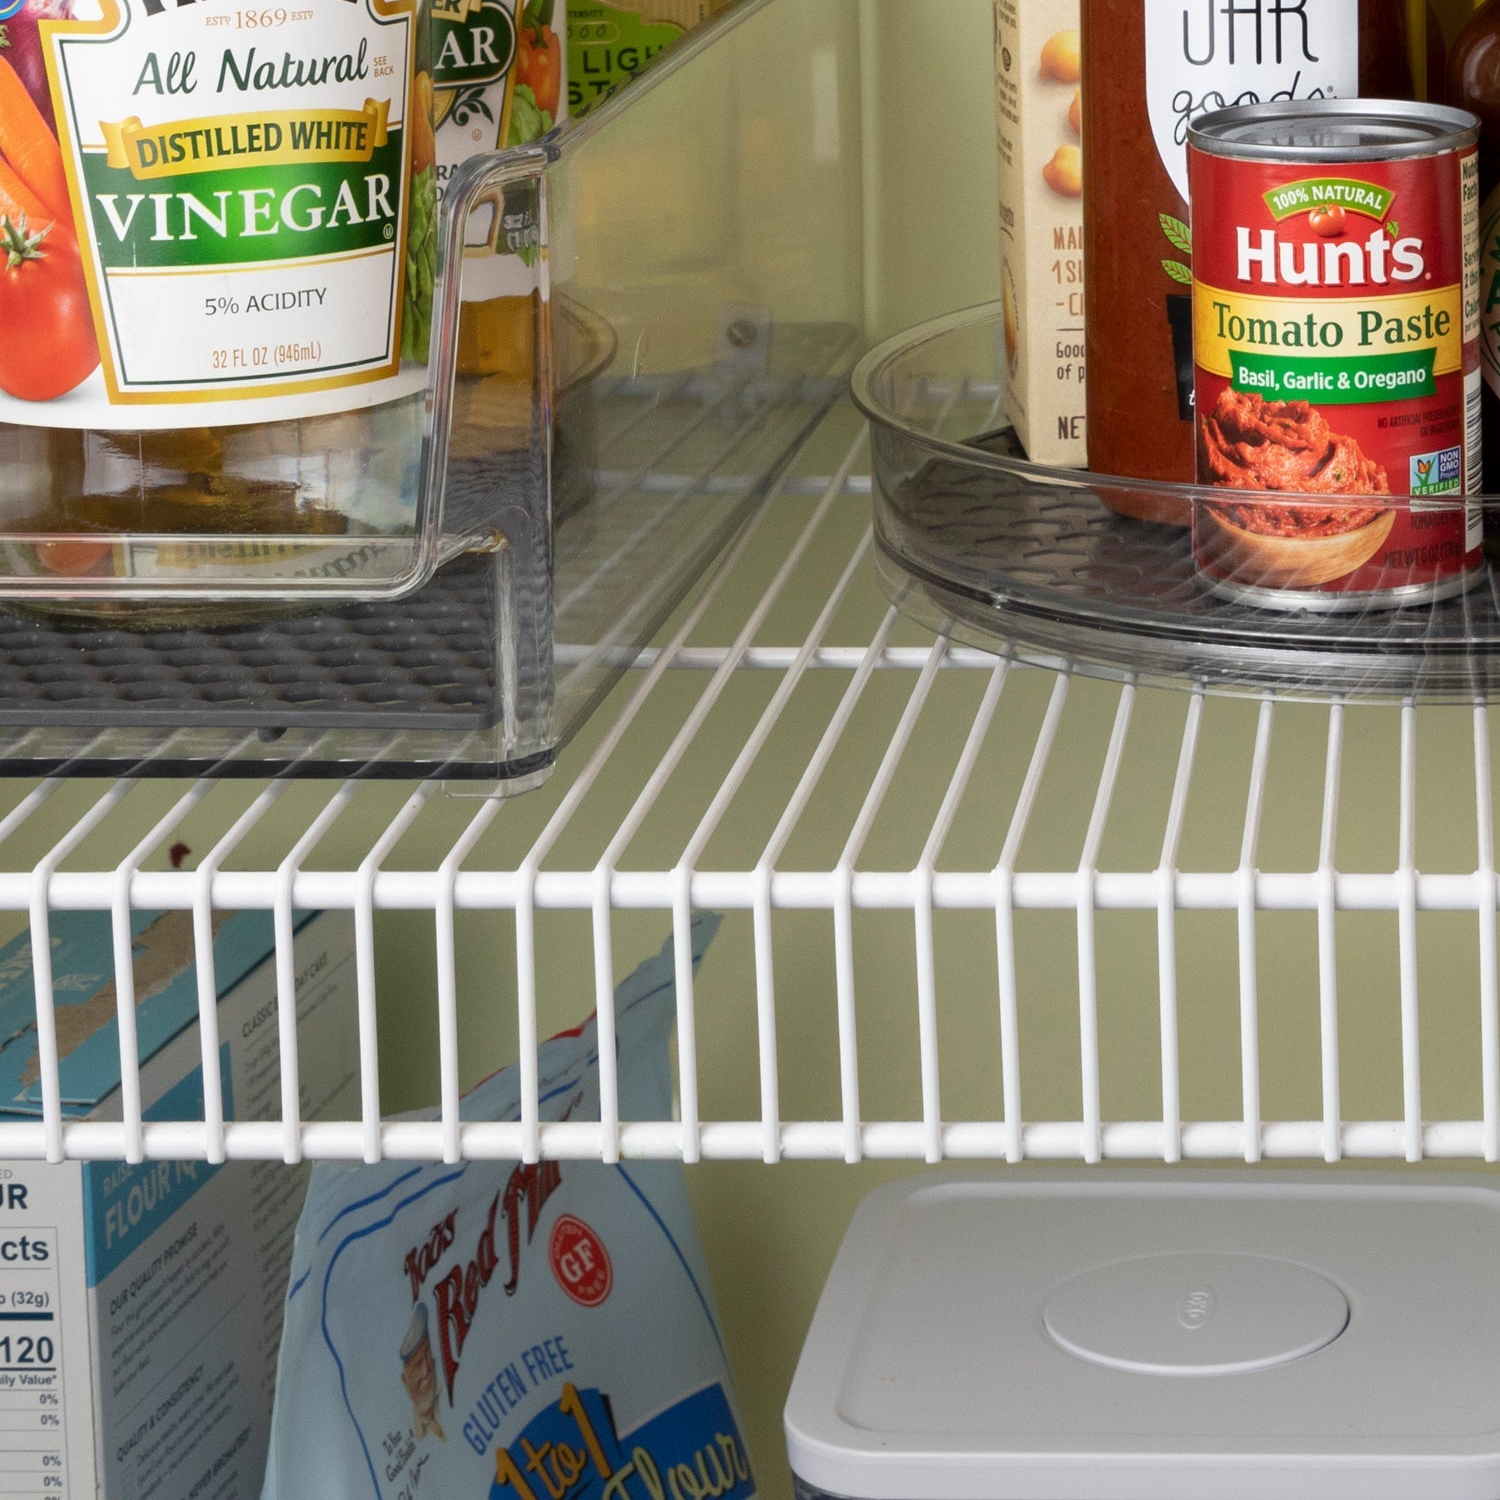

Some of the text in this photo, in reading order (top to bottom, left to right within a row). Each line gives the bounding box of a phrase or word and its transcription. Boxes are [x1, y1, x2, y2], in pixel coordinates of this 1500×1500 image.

[236, 8, 288, 29] 1869
[132, 37, 369, 95] All Natural
[373, 56, 388, 67] SEE
[374, 66, 394, 77] BACK
[136, 121, 368, 169] DISTILLED WHITE
[96, 174, 395, 242] VINEGAR
[1273, 185, 1383, 211] 100% NATURAL
[205, 287, 327, 316] 5% ACIDITY
[1213, 301, 1451, 348] Tomato Paste
[212, 341, 322, 369] 32 FL OZ (946mL)
[1057, 364, 1071, 380] of
[1239, 366, 1426, 391] Basil, Garlic & Oregano
[1440, 451, 1459, 463] NON
[1440, 461, 1459, 472] GMO
[1414, 477, 1459, 495] VERIFIED
[104, 1162, 171, 1250] FLOUR
[1, 1235, 49, 1261] cts
[559, 1238, 598, 1284] GF
[110, 1285, 131, 1316] OUR
[130, 1253, 162, 1298] QUALITY
[10, 1291, 50, 1309] (32g)
[39, 1393, 59, 1405] 0%
[462, 1335, 574, 1456] GLUTEN FREE
[40, 1414, 60, 1426] 0%
[520, 1437, 587, 1500] to
[559, 1381, 613, 1481] 1
[42, 1455, 61, 1467] 0%
[43, 1476, 63, 1488] 0%
